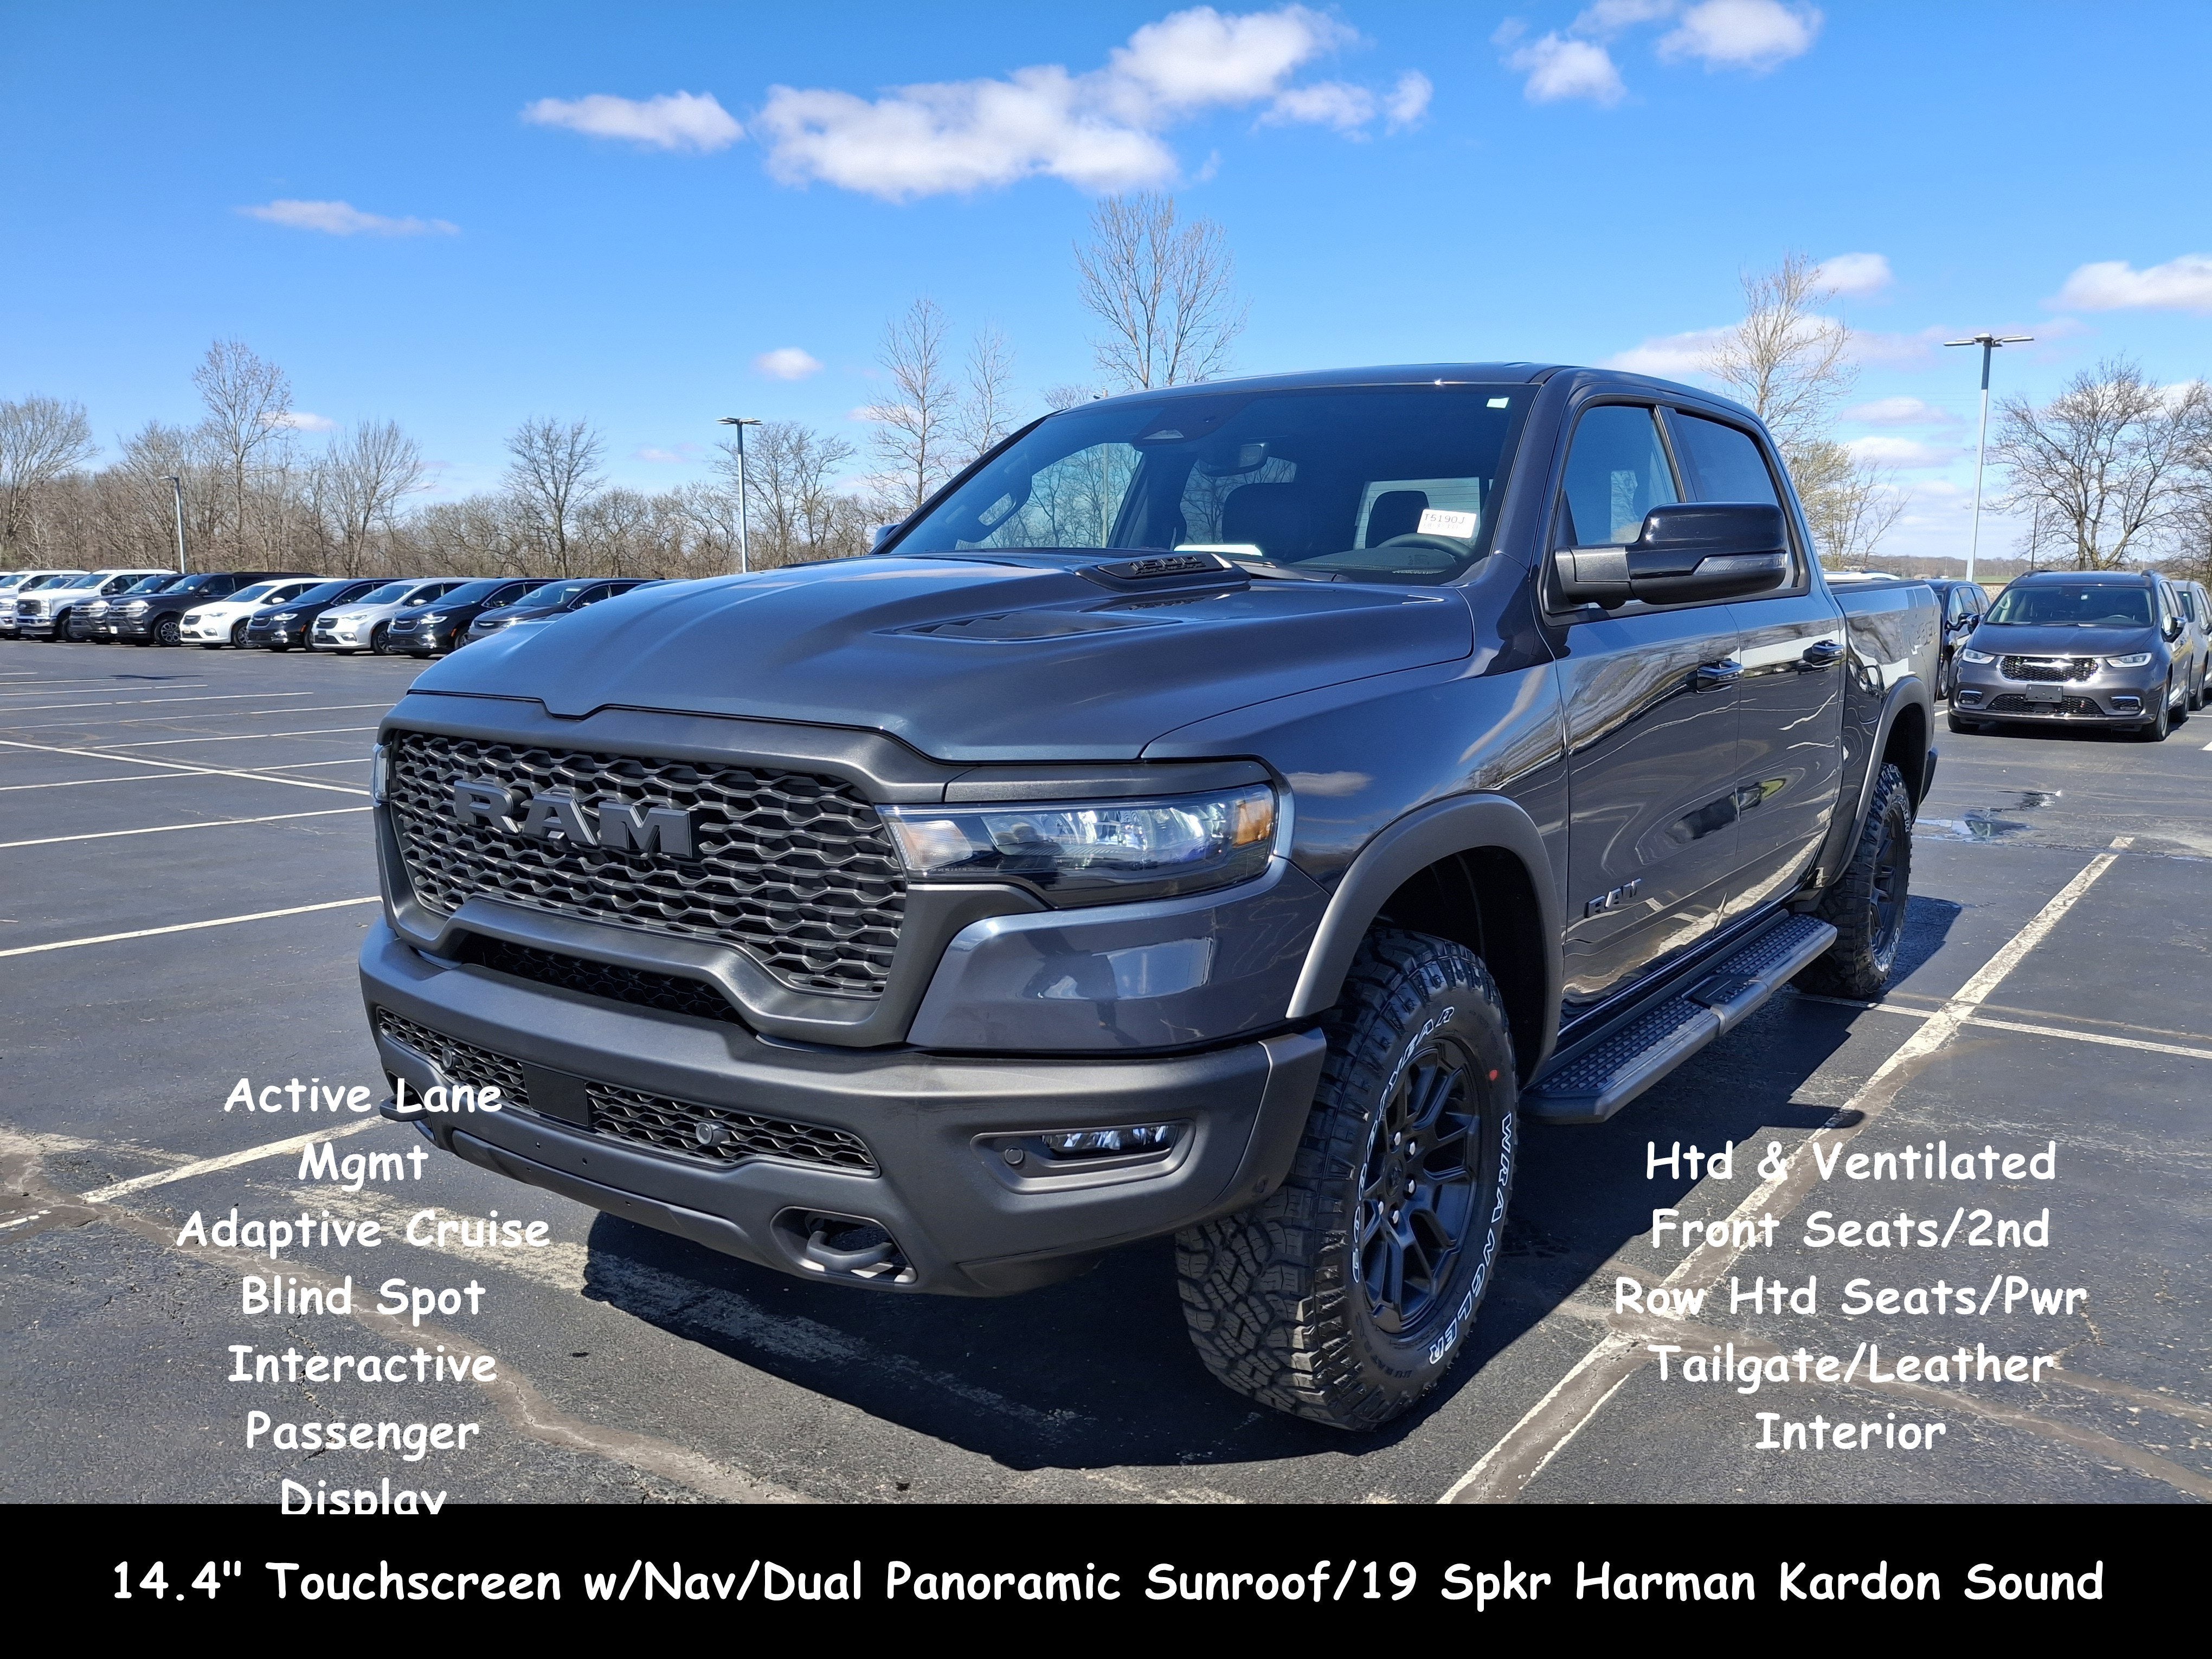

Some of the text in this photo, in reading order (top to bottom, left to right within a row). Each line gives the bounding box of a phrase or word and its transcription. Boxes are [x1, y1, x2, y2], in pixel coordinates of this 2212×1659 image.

[1424, 513, 1465, 524] T5190J
[1128, 555, 1203, 571] 1500
[454, 780, 697, 858] RAM
[1352, 1006, 1455, 1283] GOODYEAR
[1429, 1112, 1512, 1365] WRANGLER
